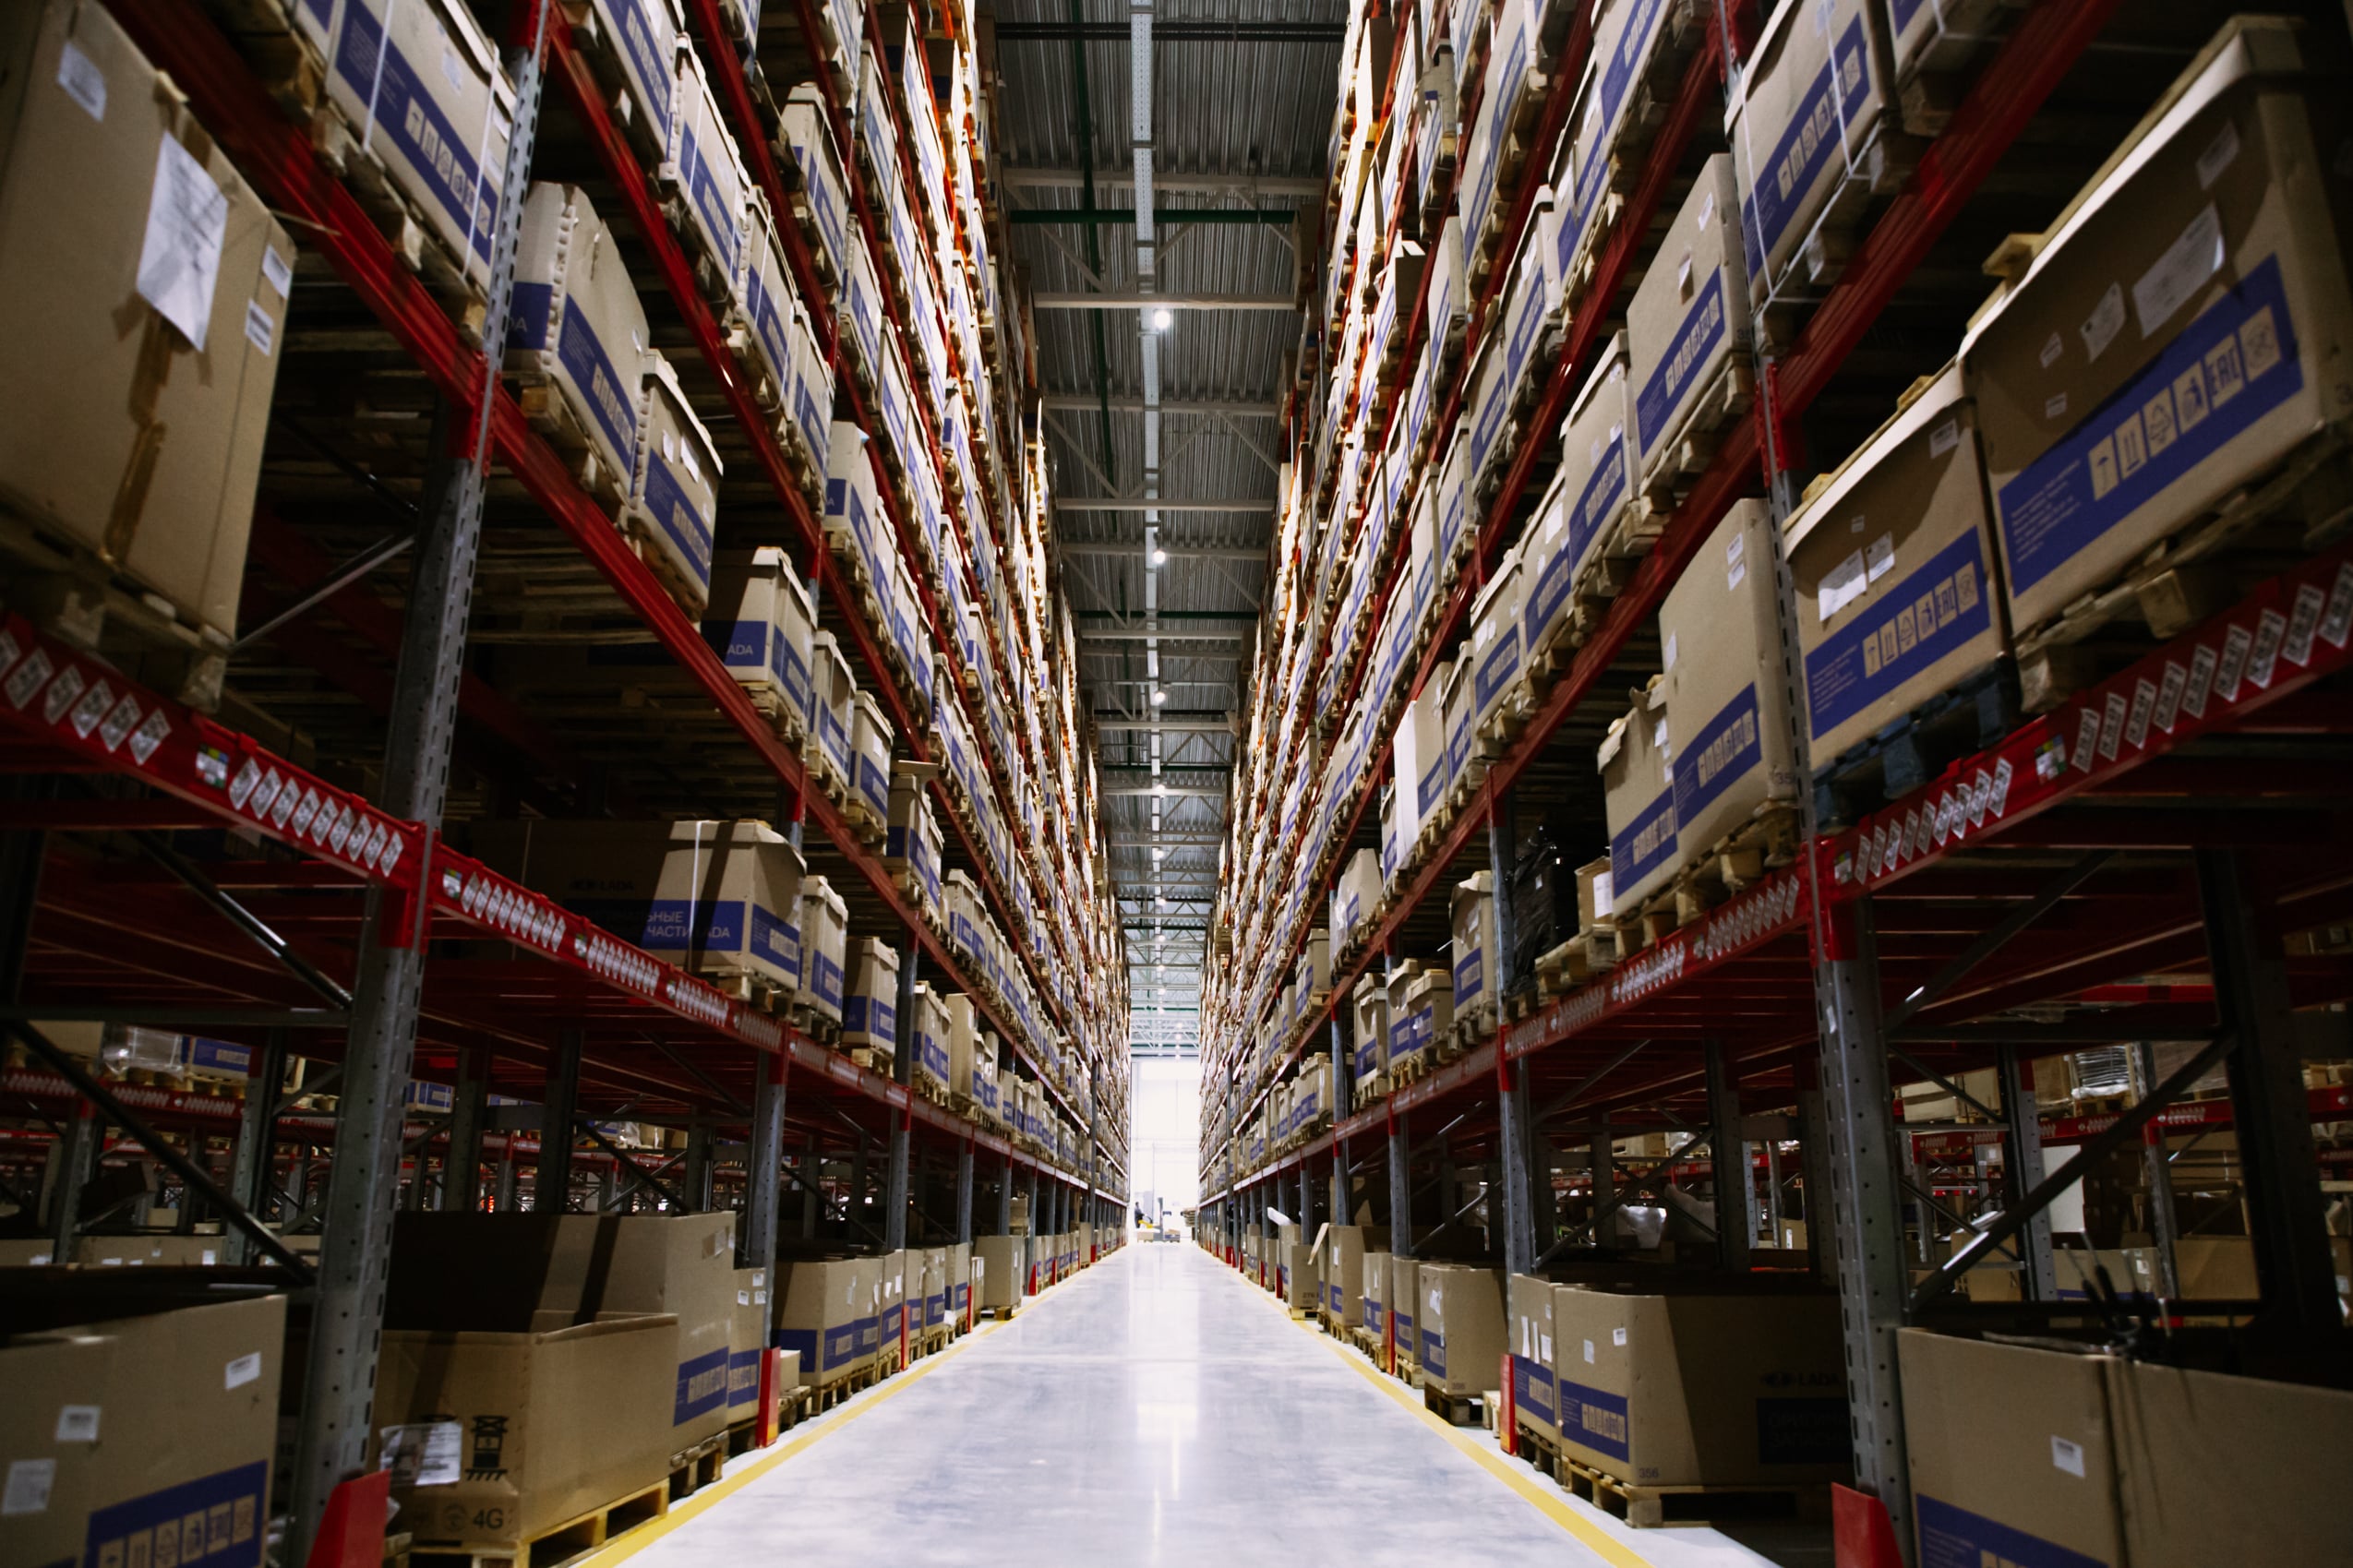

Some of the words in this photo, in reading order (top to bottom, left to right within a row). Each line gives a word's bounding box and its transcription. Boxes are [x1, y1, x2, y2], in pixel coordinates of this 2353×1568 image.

[724, 642, 754, 656] ADA
[1799, 1372, 1842, 1386] LADA
[1768, 1412, 1847, 1427] ОРИГИНА
[1639, 1467, 1660, 1478] 356
[473, 1508, 503, 1529] 4G
